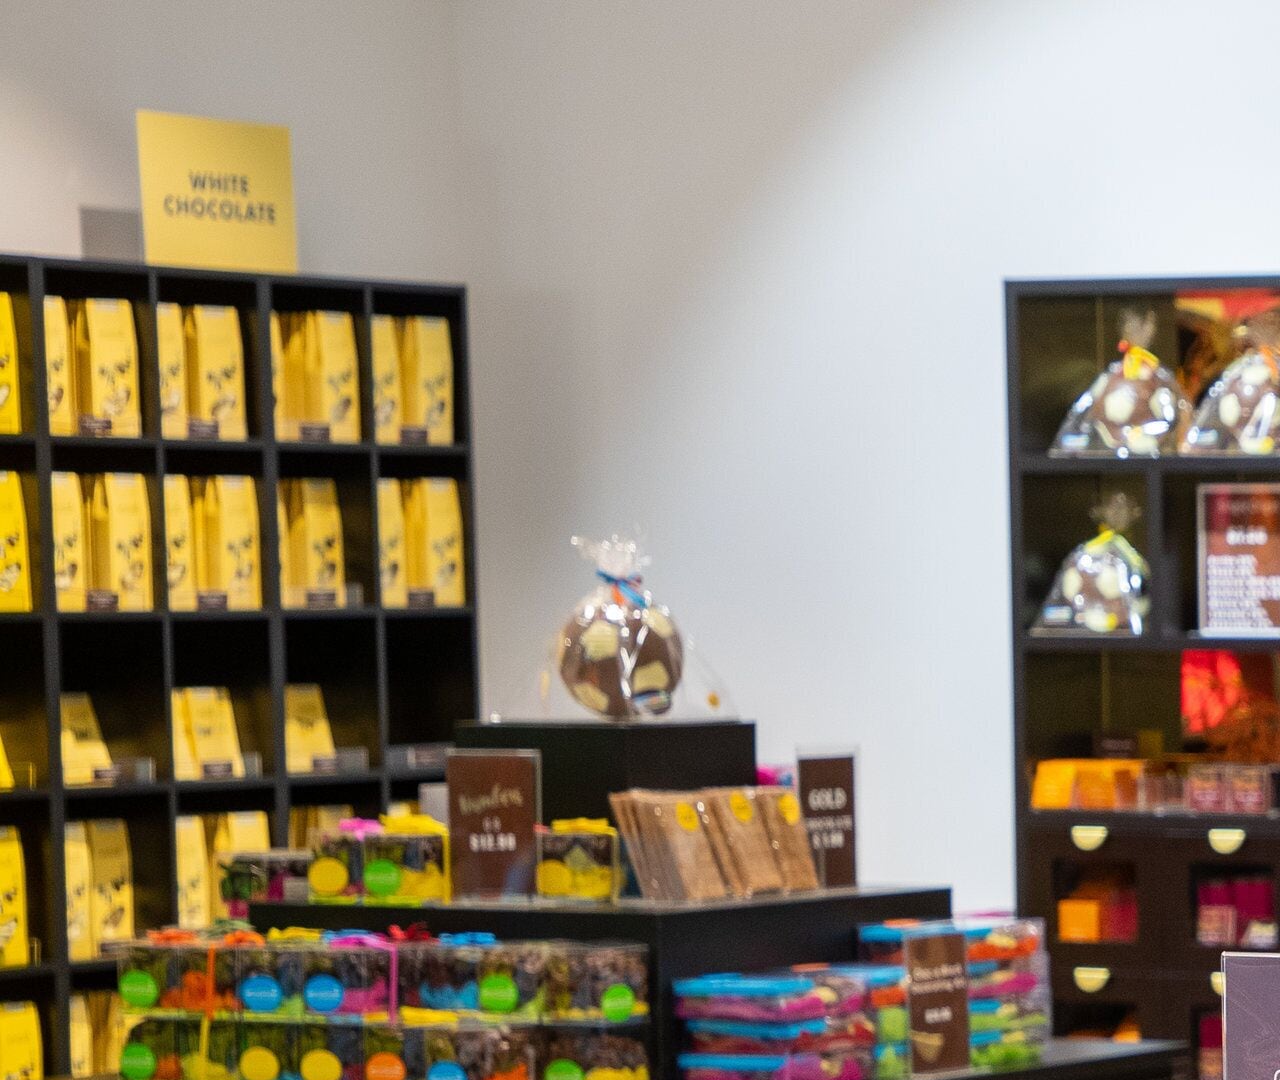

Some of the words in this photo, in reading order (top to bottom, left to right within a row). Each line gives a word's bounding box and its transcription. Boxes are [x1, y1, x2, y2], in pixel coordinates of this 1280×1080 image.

[188, 170, 248, 196] WHITE
[163, 194, 276, 224] CHOCOLATE
[808, 787, 848, 811] GOLD
